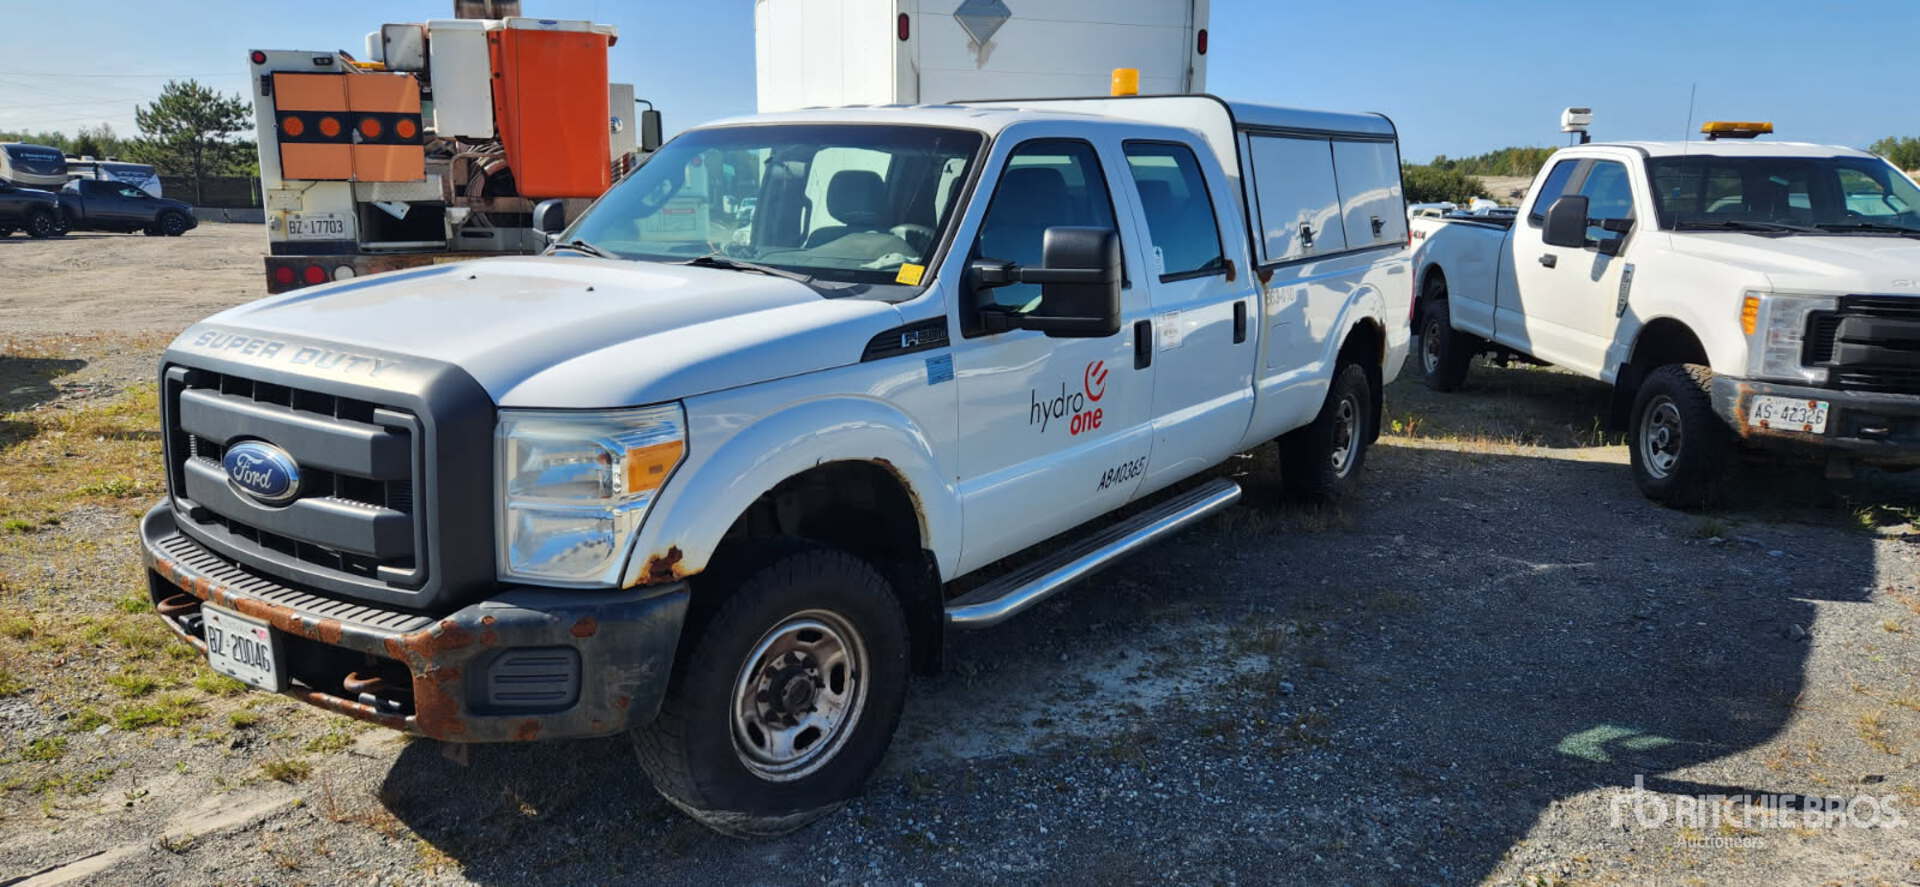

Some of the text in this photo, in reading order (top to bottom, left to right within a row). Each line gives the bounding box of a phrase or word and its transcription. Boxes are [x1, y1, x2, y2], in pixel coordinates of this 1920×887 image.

[311, 220, 344, 235] 17703
[193, 330, 400, 378] SUPER DUTY
[1030, 381, 1084, 433] hydro
[1070, 407, 1103, 436] one
[232, 453, 274, 489] Ford
[207, 625, 271, 673] BZ 20046
